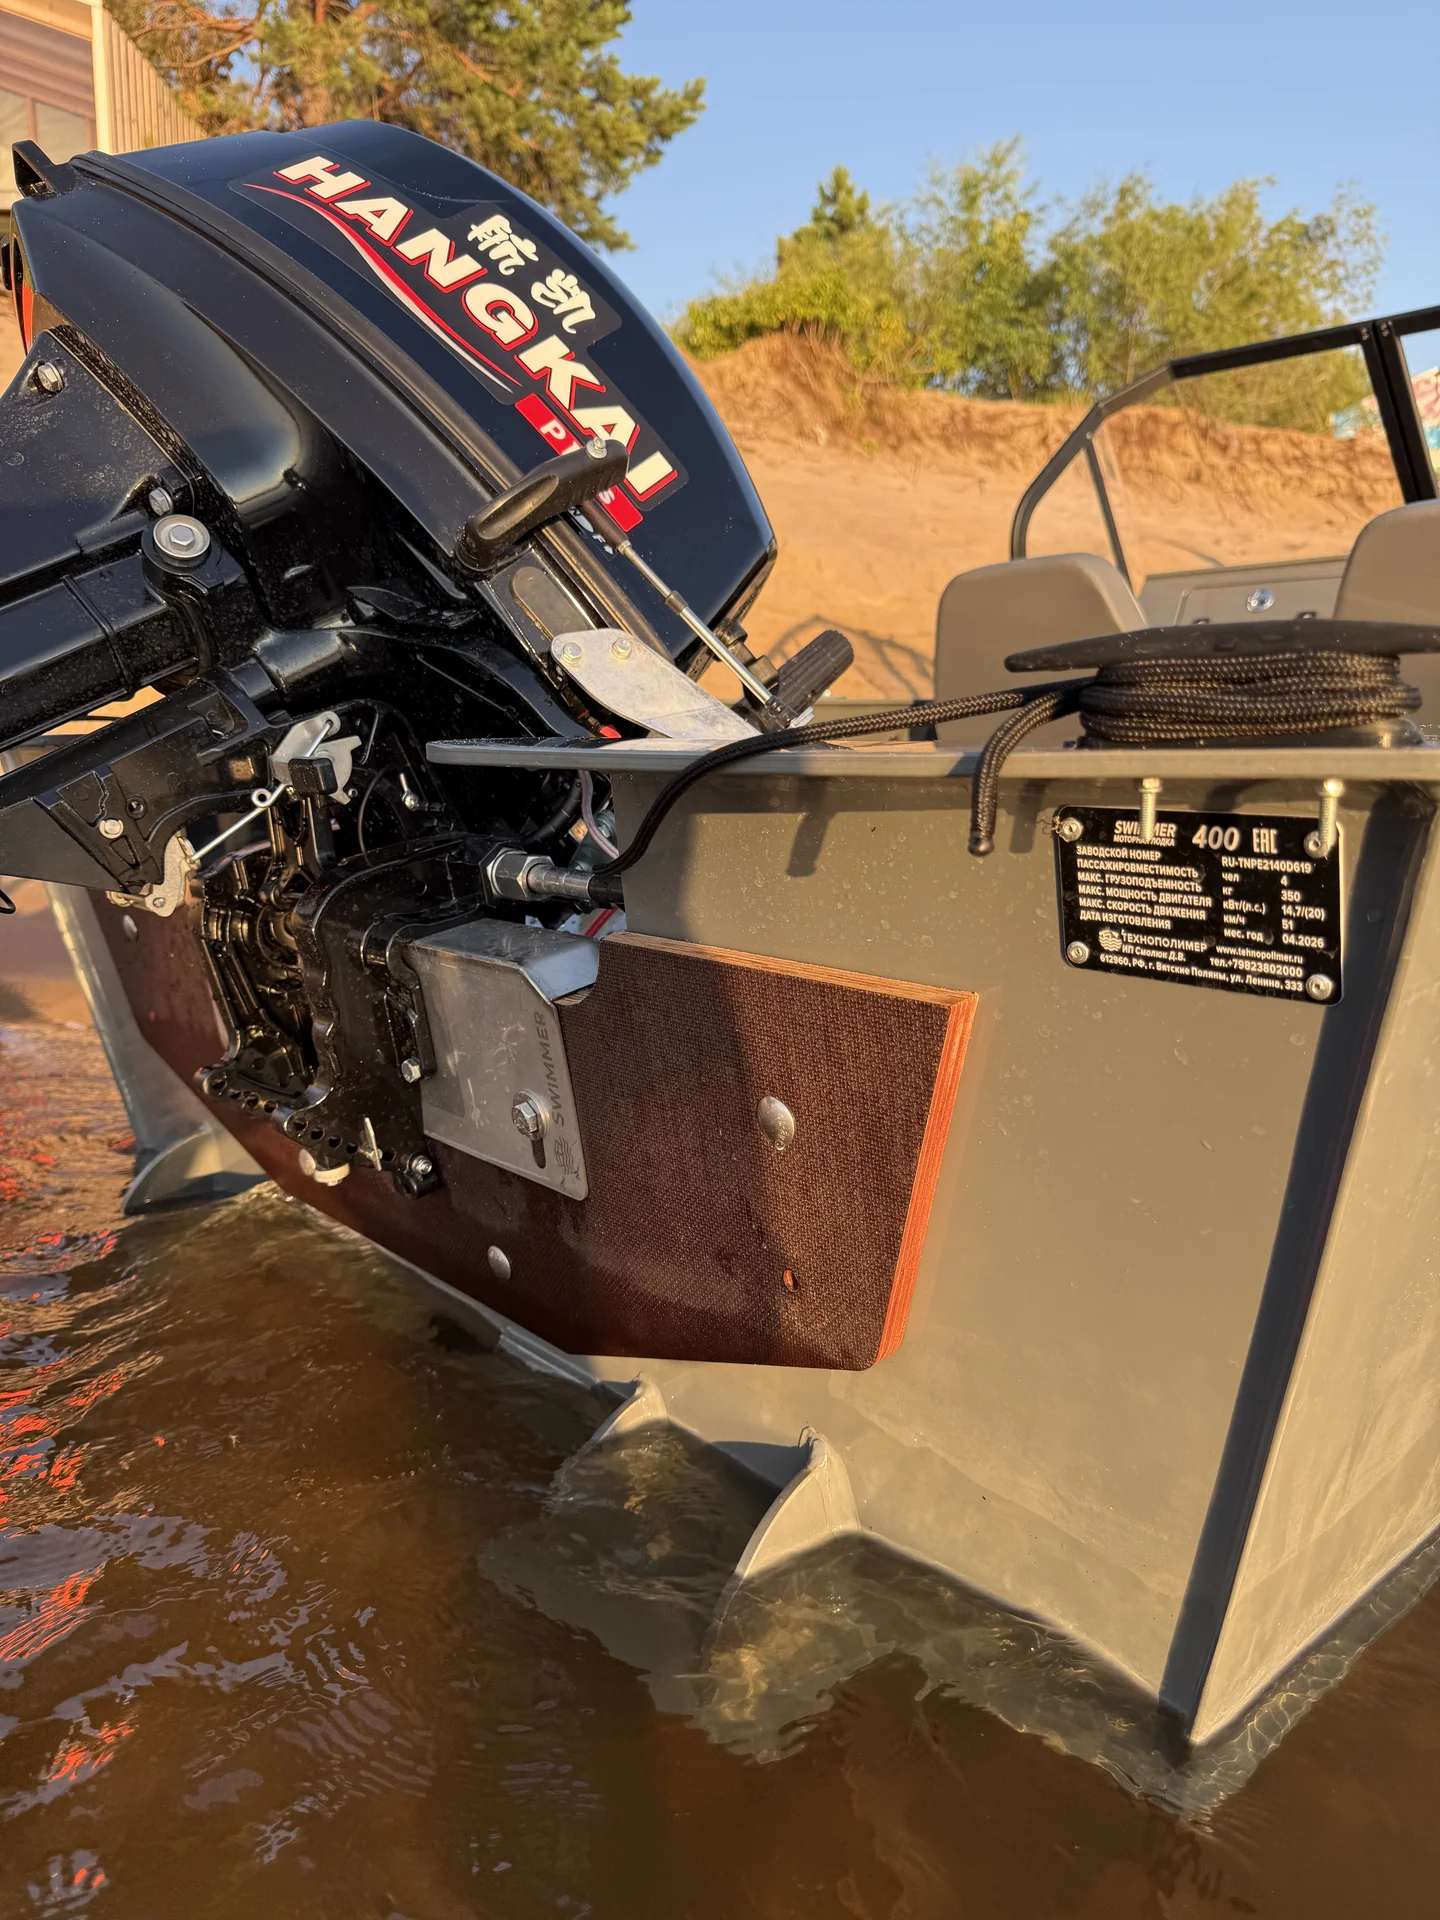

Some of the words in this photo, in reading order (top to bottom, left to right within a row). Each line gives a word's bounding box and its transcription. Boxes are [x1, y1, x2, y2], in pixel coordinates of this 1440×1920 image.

[274, 156, 678, 501] HANGKAI
[1192, 825, 1240, 851] 400
[1252, 828, 1278, 854] EAC
[1076, 846, 1128, 859] ЗАВОДСКОЙ
[1130, 849, 1161, 861] НОМЕР
[1077, 859, 1198, 878] ПАССАЖИРОВМЕСТИМОСТЬ
[1221, 856, 1312, 874] RU-TNPE2140D619
[1077, 872, 1104, 883] МАКС.
[1105, 874, 1202, 893] ГРУЗОПОДЪЕМНОСТЬ
[1222, 872, 1239, 882] чел
[1280, 875, 1288, 887] 4
[1078, 885, 1104, 896] МАКС.
[1106, 887, 1157, 901] МОЩНОСТЬ
[1159, 893, 1212, 907] ДВИГАТЕЛЯ
[1222, 886, 1233, 896] кг
[1281, 890, 1301, 902] 350
[1079, 898, 1105, 908] МАКС.
[1107, 900, 1151, 914] СКОРОСТЬ
[1153, 905, 1206, 920] ДВИЖЕНИЯ
[1223, 900, 1266, 915] кВт/(л.с.)
[1281, 904, 1325, 921] 14,7/(20)
[1080, 910, 1101, 921] ДАТА
[1102, 913, 1171, 930] ИЗГОТОВЛЕНИЯ
[1223, 914, 1245, 925] км/ч
[1282, 919, 1293, 930] 51
[1121, 930, 1207, 952] ТЕХНОПОЛИМЕР
[1224, 928, 1244, 938] мес.
[1246, 932, 1263, 943] год
[1282, 933, 1324, 948] 04.2026
[1122, 945, 1134, 954] ИП
[1135, 946, 1167, 959] Смолюк
[1169, 951, 1186, 962] Д.В.
[1216, 945, 1303, 963] www.tehnopolimer.ru
[1100, 953, 1132, 967] 612960,
[1132, 959, 1148, 970] РФ,
[1156, 962, 1189, 975] Вятские
[1191, 966, 1229, 981] Поляны,
[1230, 973, 1244, 983] ул.
[1246, 975, 1283, 990] Ленина,
[1284, 980, 1303, 991] 333
[1210, 957, 1303, 977] тел.+79823802000
[533, 1011, 565, 1127] SWIMMER
